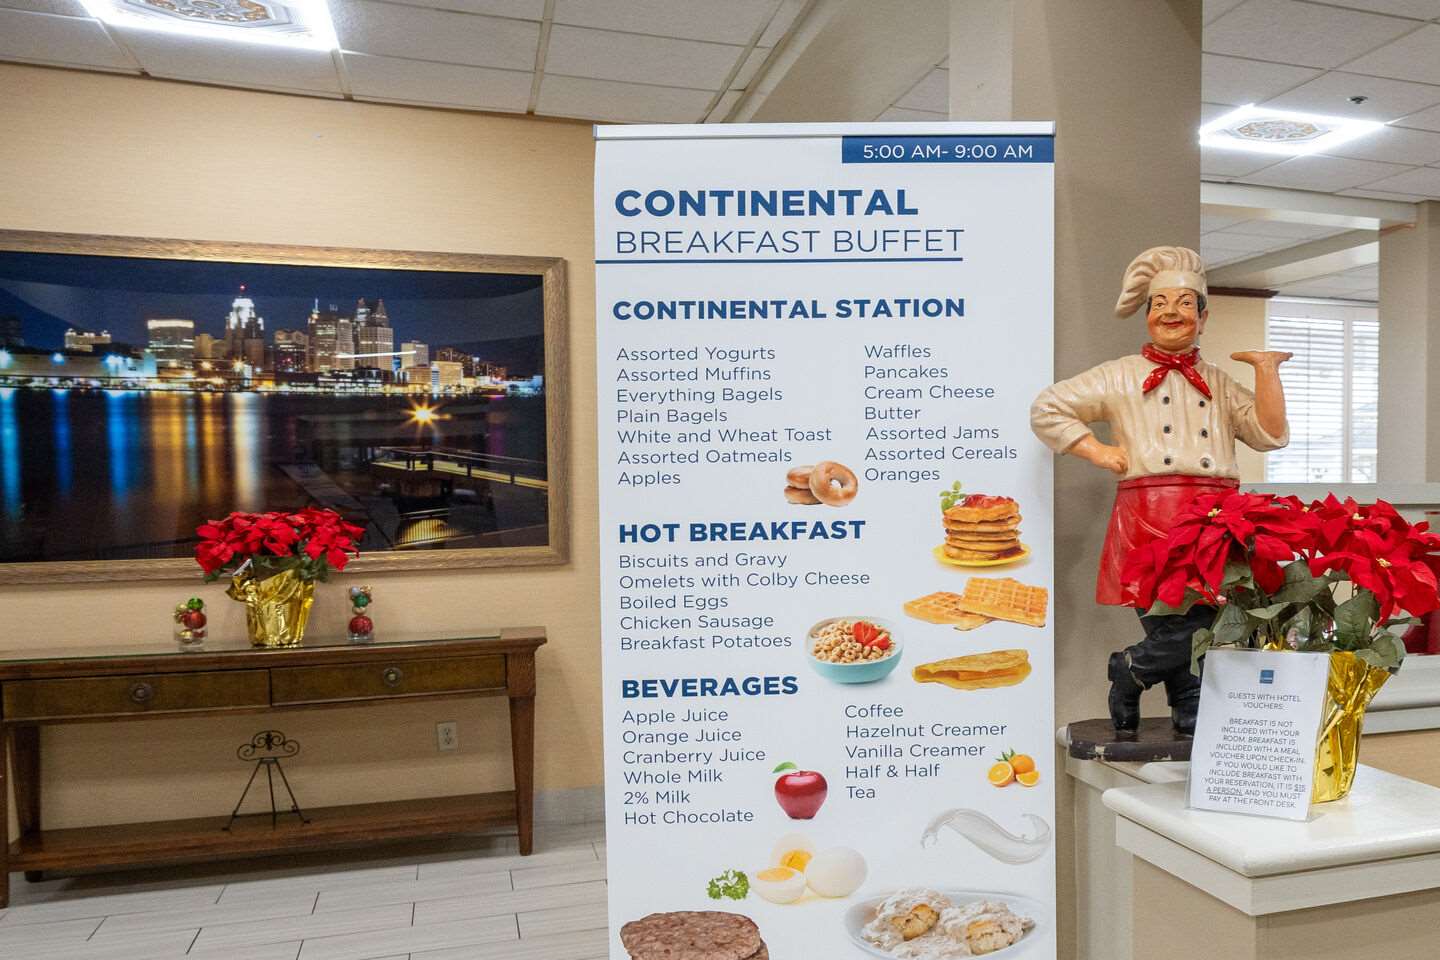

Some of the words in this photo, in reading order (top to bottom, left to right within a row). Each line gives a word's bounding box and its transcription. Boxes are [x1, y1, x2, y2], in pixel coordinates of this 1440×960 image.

[863, 144, 905, 159] 5:00
[954, 144, 997, 159] 9:00
[1003, 144, 1033, 159] AM
[614, 189, 919, 217] CONTINENTAL
[616, 230, 821, 254] BREAKFAST
[834, 229, 965, 253] BUFFET
[612, 299, 827, 321] CONTINENTAL
[835, 298, 965, 319] STATION
[616, 346, 698, 361] Assorted
[704, 346, 776, 363] Yogurts
[864, 344, 931, 359] Waffles
[616, 367, 699, 383] Assorted
[705, 366, 771, 381] Muffins
[864, 364, 949, 380] Pancakes
[616, 387, 715, 405] Everything
[722, 386, 783, 404] Bagels
[864, 385, 923, 400] Cream
[929, 384, 995, 399] Cheese
[617, 408, 660, 424] Plain
[667, 408, 728, 425] Bagels
[864, 406, 921, 420] Butter
[616, 429, 672, 444] White
[676, 428, 711, 444] and
[717, 428, 778, 443] Wheat
[783, 427, 832, 442] Toast
[865, 425, 947, 441] Assorted
[952, 425, 1000, 440] Jams
[617, 449, 699, 465] Assorted
[705, 448, 793, 464] Oatmeals
[864, 445, 945, 461] Assorted
[951, 445, 1018, 460] Cereals
[617, 470, 681, 488] Apples
[864, 467, 940, 484] Oranges
[619, 523, 681, 544] HOT
[689, 520, 866, 542] BREAKFAST
[619, 553, 689, 569] Biscuits
[695, 552, 729, 568] and
[735, 552, 788, 569] Gravy
[619, 574, 695, 589] Omelets
[701, 573, 740, 588] with
[746, 571, 799, 589] Colby
[804, 571, 870, 586] Cheese
[620, 594, 676, 610] Boiled
[683, 594, 729, 611] Eggs
[620, 615, 692, 631] Chicken
[697, 614, 775, 630] Sausage
[620, 635, 705, 651] Breakfast
[711, 634, 792, 649] Potatoes
[621, 675, 799, 699] BEVERAGES
[621, 708, 676, 726] Apple
[681, 708, 729, 723] Juice
[844, 703, 904, 719] Coffee
[1229, 718, 1268, 726] BREAKFAST
[622, 730, 689, 746] Orange
[695, 728, 742, 743] Juice
[846, 723, 925, 739] Hazelnut
[931, 723, 1008, 737] Creamer
[622, 749, 713, 765] Cranberry
[719, 748, 766, 762] Juice
[845, 743, 903, 759] Vanilla
[909, 743, 986, 758] Creamer
[623, 769, 681, 785] Whole
[688, 768, 723, 783] Milk
[845, 764, 881, 779] Half
[886, 764, 899, 778] &
[905, 763, 941, 778] Half
[1209, 769, 1241, 777] INCLUDE
[1242, 772, 1281, 780] BREAKFAST
[623, 791, 649, 805] 2%
[655, 789, 691, 805] Milk
[845, 785, 876, 800] Tea
[1262, 790, 1278, 798] YOU
[624, 811, 657, 825] Hot
[662, 808, 755, 825] Chocolate
